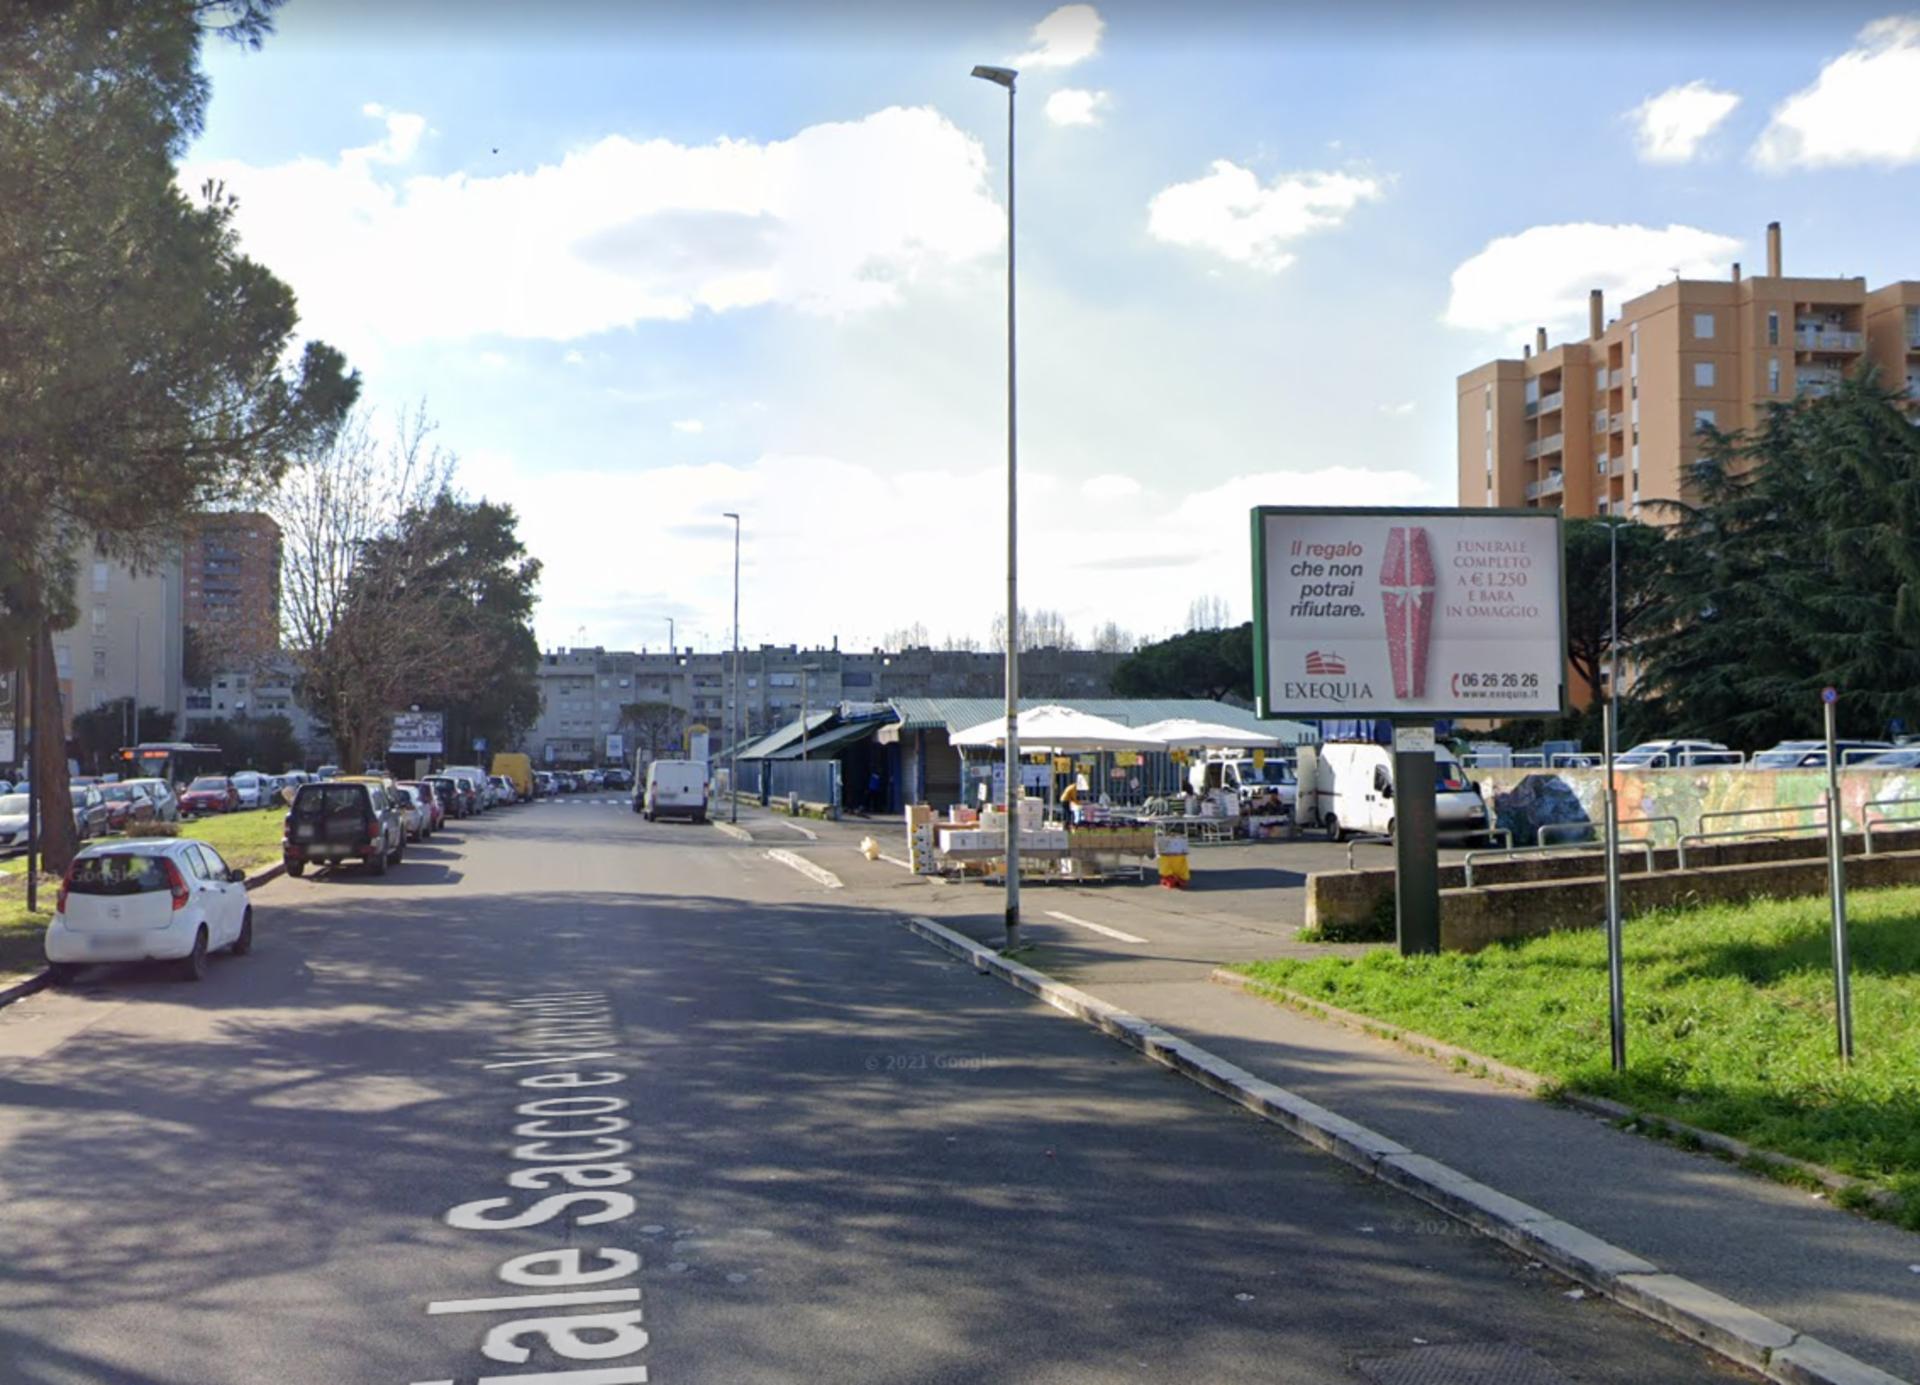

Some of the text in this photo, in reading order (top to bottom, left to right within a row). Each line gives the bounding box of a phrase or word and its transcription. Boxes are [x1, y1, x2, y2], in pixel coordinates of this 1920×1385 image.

[1290, 540, 1363, 560] Il regalo
[1457, 541, 1527, 553] FUNERALE
[1290, 560, 1363, 577] che non
[1453, 556, 1531, 568] COMPLETO
[1458, 575, 1467, 586] A
[1300, 580, 1355, 600] potrai
[1468, 590, 1514, 601] E BARA
[1290, 600, 1365, 617] rifiutare.
[1446, 605, 1538, 617] IN OMAGGIO
[1462, 673, 1538, 687] 06 26 26 26
[1285, 682, 1373, 702] EXEQUIA
[517, 1072, 627, 1088] e
[445, 1097, 635, 1231] Sacco
